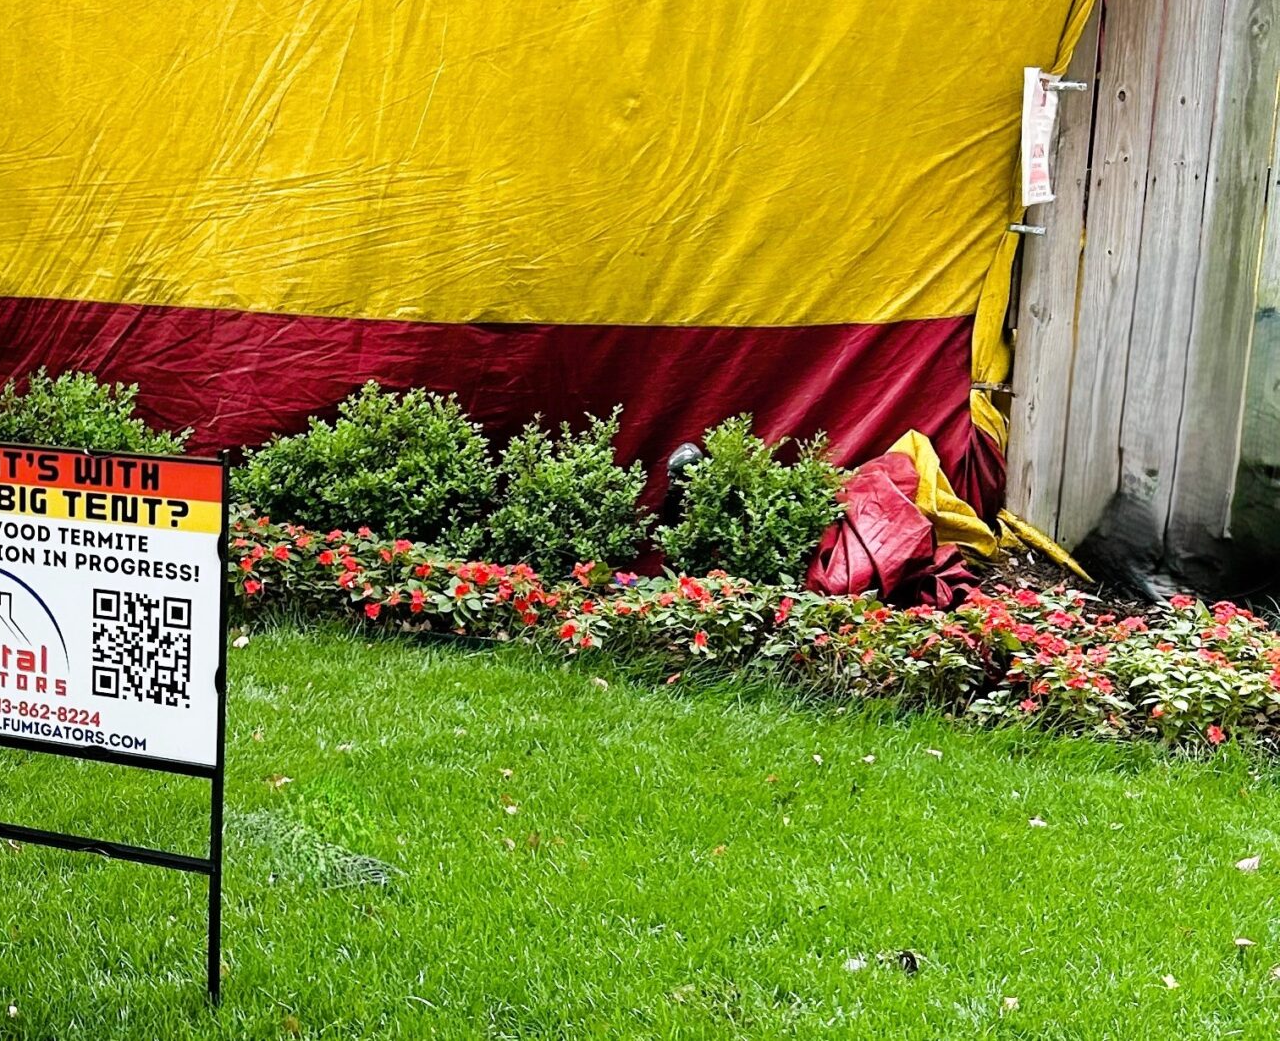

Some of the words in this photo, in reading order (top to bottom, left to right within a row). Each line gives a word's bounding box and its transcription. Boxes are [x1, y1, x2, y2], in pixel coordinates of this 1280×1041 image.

[74, 458, 160, 491] WITH
[63, 490, 190, 527] TENT?
[58, 527, 149, 553] TERMITE
[43, 549, 67, 568] IN
[75, 553, 200, 582] PROGRESS!
